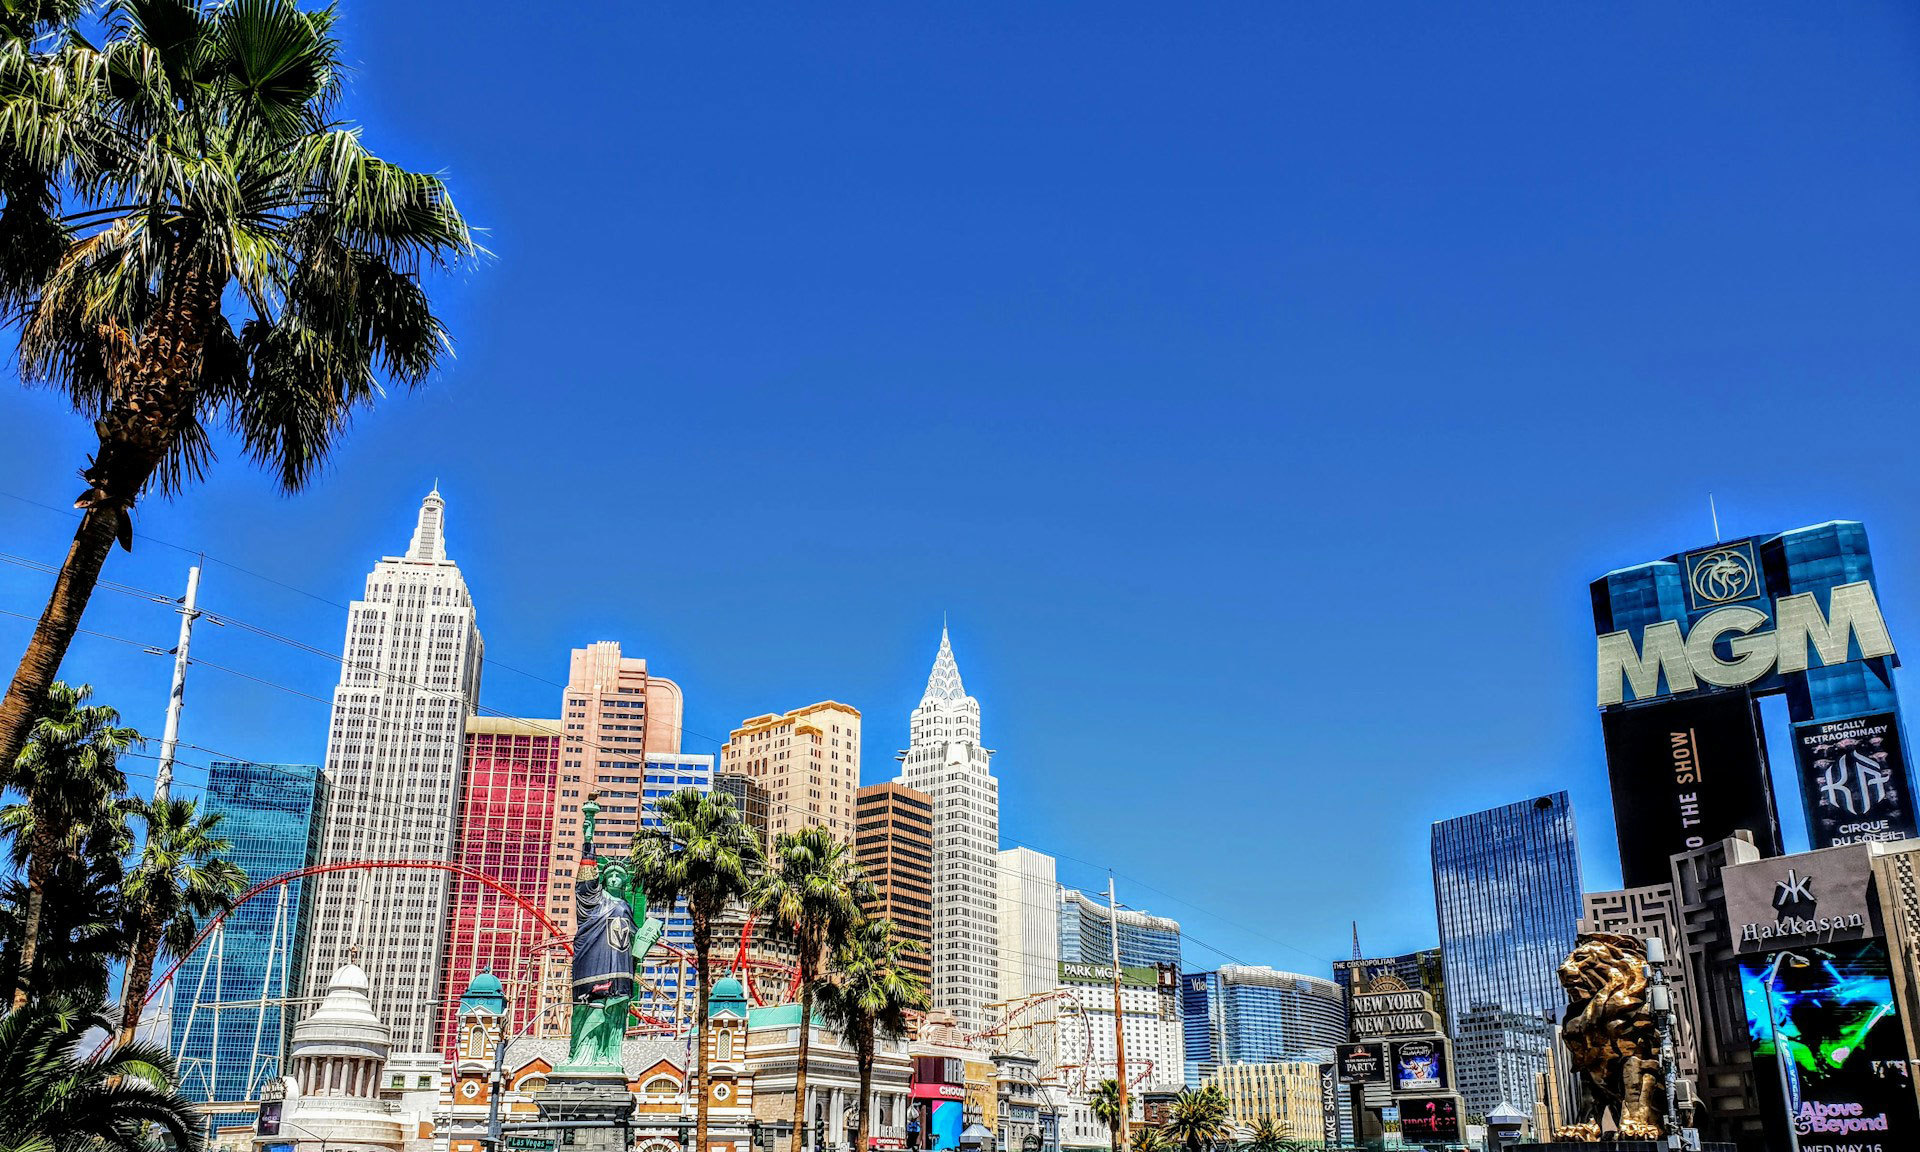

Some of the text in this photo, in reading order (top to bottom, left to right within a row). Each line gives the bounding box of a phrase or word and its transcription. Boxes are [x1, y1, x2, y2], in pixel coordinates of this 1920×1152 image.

[1597, 580, 1895, 707] MGM
[1803, 725, 1888, 745] EXTRAORDINARY
[1822, 720, 1866, 733] EPICALLY
[1670, 732, 1704, 849] O THE SHOW
[1839, 820, 1889, 834] CIRQUE
[1832, 836, 1851, 847] DU
[1741, 911, 1864, 942] Hakkasan
[1064, 964, 1123, 979] PARK MG
[1333, 958, 1396, 970] THE COSMOPOLITAN
[1354, 992, 1423, 1013] NEW YORK
[1355, 1013, 1425, 1033] NEW YORK
[1322, 1072, 1335, 1111] SHACK
[1800, 1101, 1863, 1117] Above
[1810, 1113, 1888, 1135] Beyond
[512, 1138, 525, 1146] Las
[525, 1138, 545, 1149] Vegas
[1836, 1144, 1863, 1152] MAY
[1866, 1143, 1882, 1152] 16
